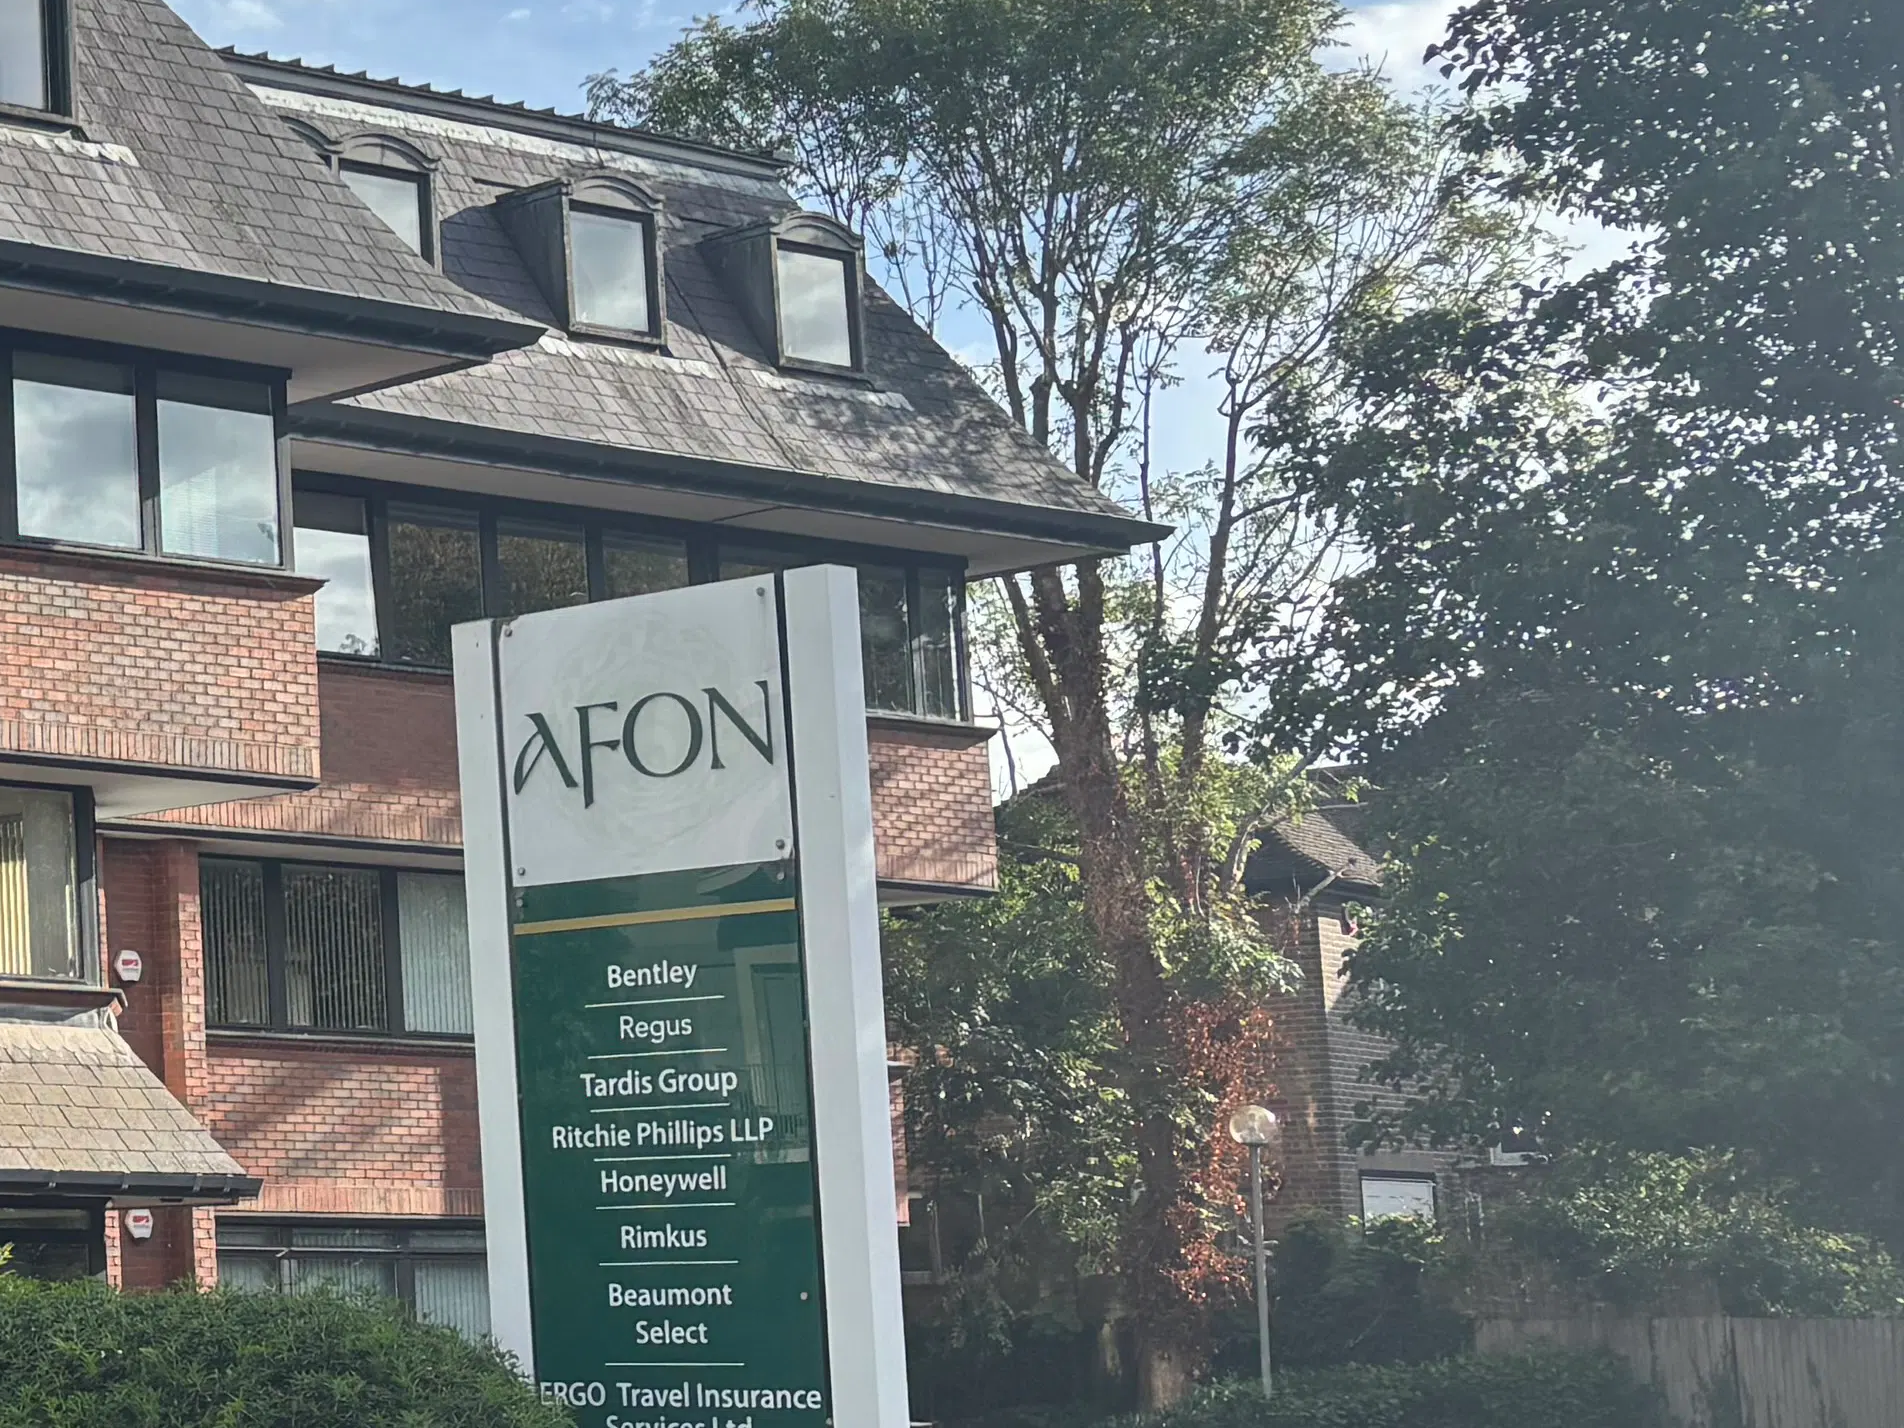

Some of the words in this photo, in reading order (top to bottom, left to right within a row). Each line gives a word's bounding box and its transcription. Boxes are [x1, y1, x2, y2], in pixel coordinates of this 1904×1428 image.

[513, 680, 774, 809] AFON
[607, 960, 698, 988] Bentley
[619, 1016, 693, 1043] Regus
[580, 1070, 653, 1097] Tardis
[658, 1069, 738, 1096] Group
[552, 1123, 631, 1149] Ritchie
[637, 1120, 724, 1149] Phillips
[730, 1117, 774, 1141] LLP
[601, 1165, 727, 1197] Honeywell
[620, 1223, 707, 1249] Rimkus
[608, 1283, 733, 1307] Beaumont
[635, 1319, 708, 1344] Select
[540, 1381, 606, 1407] ERGO
[615, 1381, 690, 1408] Travel
[696, 1382, 822, 1409] Insurance
